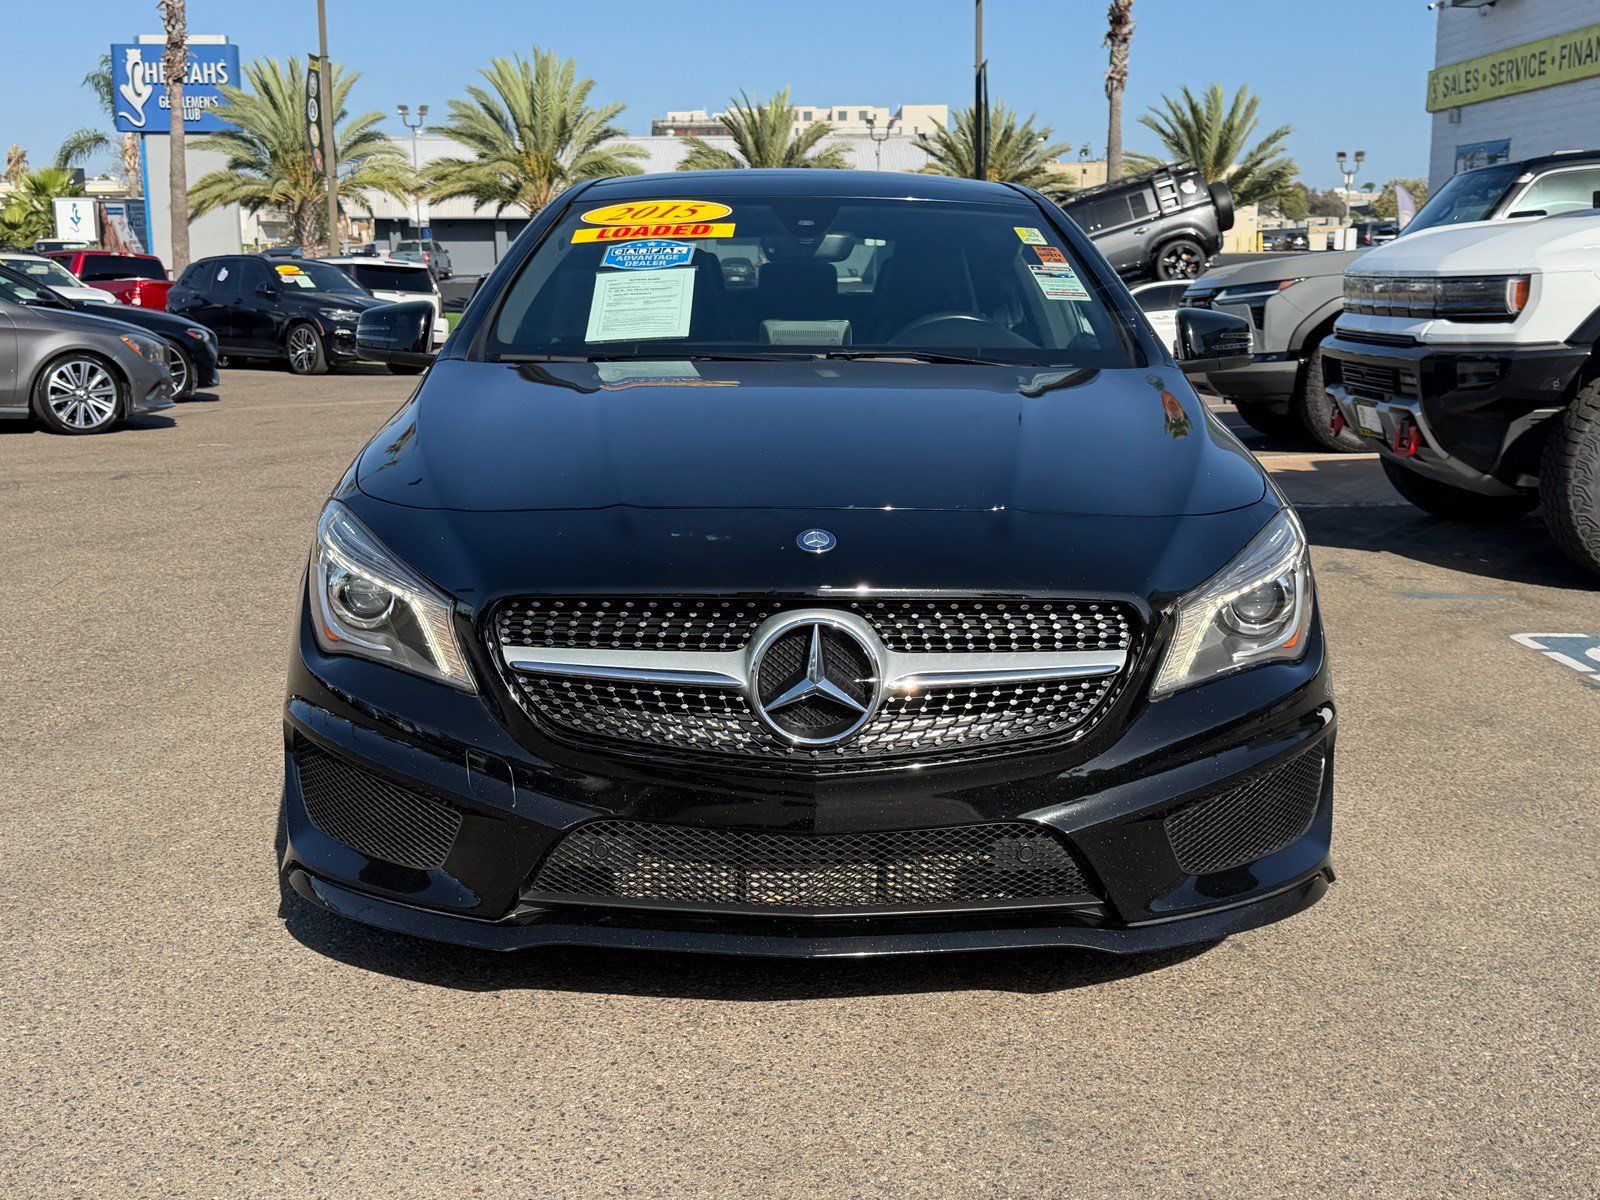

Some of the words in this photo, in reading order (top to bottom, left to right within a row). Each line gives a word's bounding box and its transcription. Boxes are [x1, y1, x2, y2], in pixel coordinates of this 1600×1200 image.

[1441, 68, 1480, 98] SALES
[1489, 50, 1548, 87] SERVICE
[181, 108, 202, 121] LUB
[603, 204, 707, 221] 2015
[596, 224, 712, 239] LOADED
[615, 254, 680, 262] ADVANTAGE
